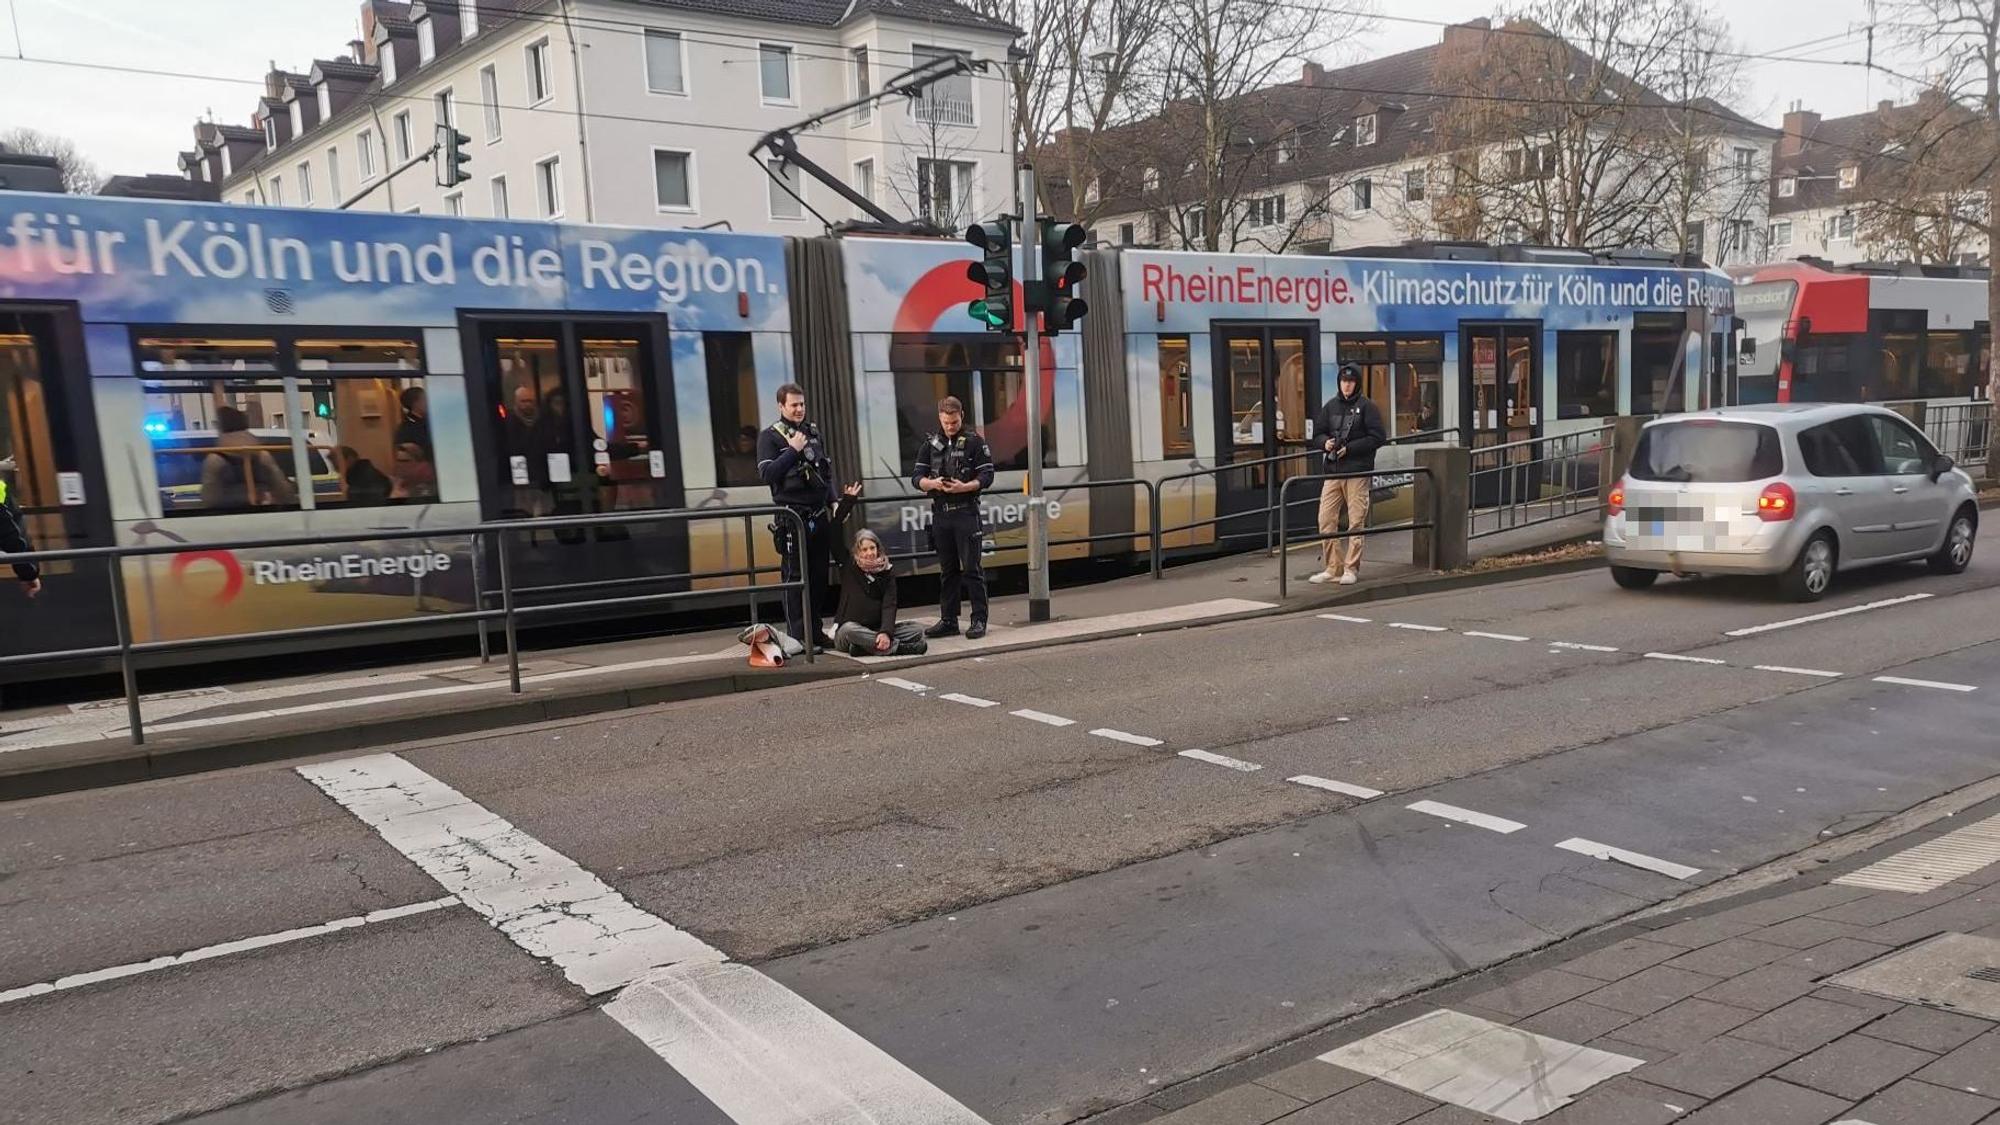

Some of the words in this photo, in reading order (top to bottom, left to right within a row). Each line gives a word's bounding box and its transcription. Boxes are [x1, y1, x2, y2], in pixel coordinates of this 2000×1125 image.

[7, 211, 126, 276] für
[145, 217, 314, 282] Köln
[331, 231, 457, 285] und
[473, 233, 564, 288] die
[580, 238, 779, 303] Region.
[1142, 263, 1355, 312] RheinEnergie.
[1362, 269, 1516, 305] Klimaschutz
[1521, 275, 1553, 306] für
[1558, 274, 1606, 306] Köln
[1610, 275, 1649, 307] und
[1653, 276, 1682, 307] die
[254, 548, 452, 587] RheinEnergie
